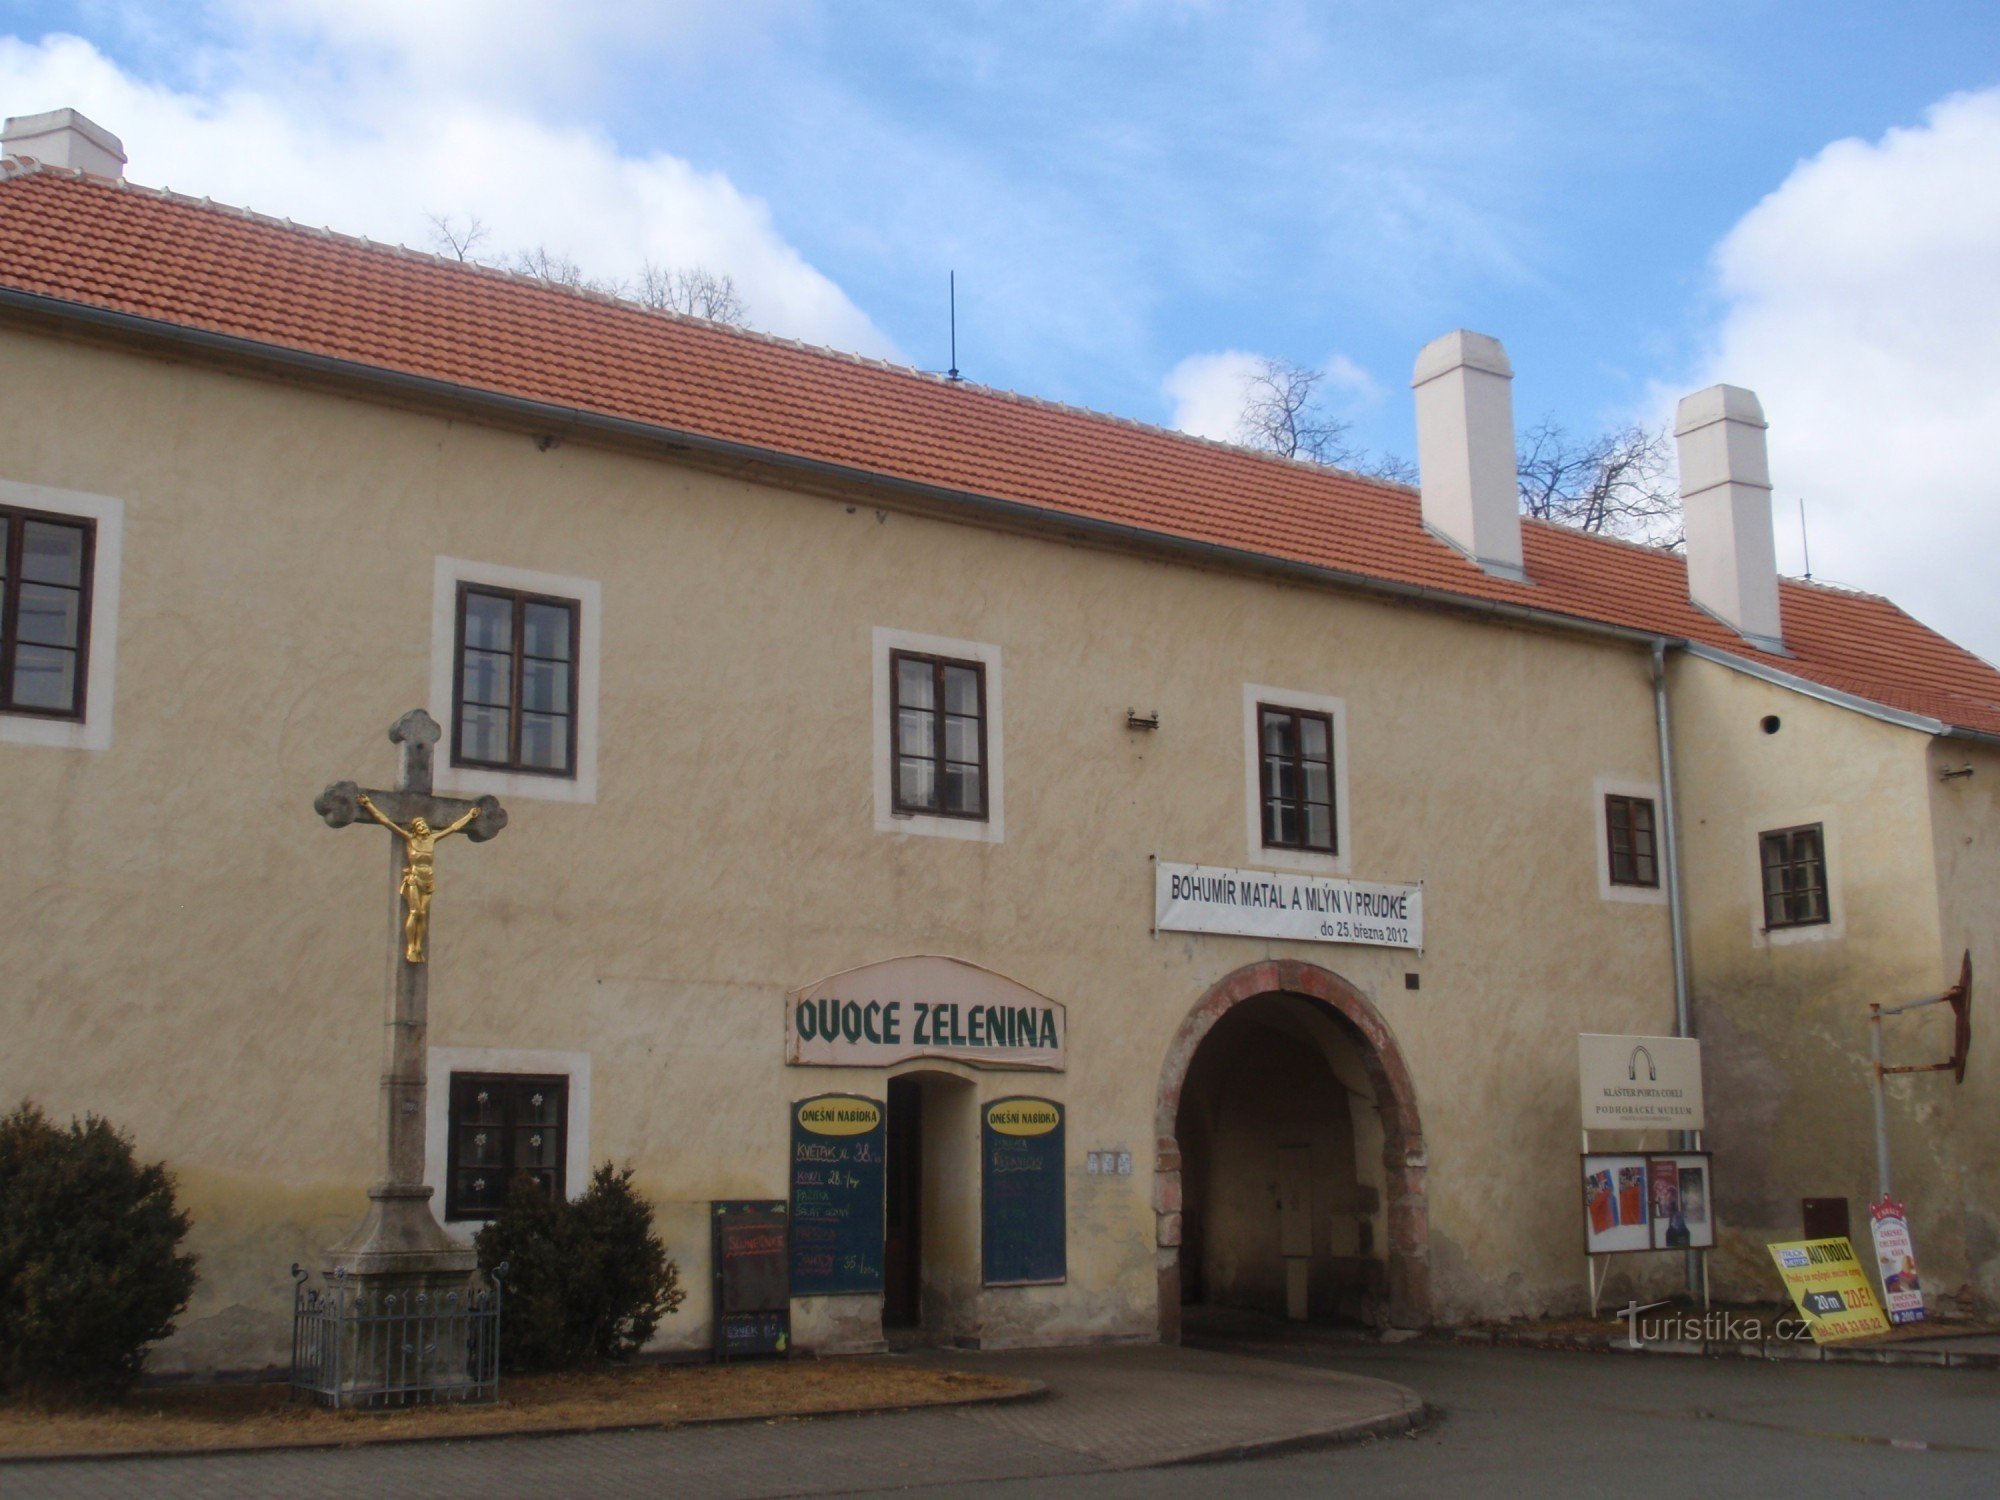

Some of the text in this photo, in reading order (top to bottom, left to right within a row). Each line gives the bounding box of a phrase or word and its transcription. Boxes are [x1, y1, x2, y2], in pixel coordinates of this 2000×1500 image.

[1171, 874, 1408, 920] BOHUMÍR MATAL A MLÝN V PRUDKÉ
[1320, 921, 1409, 944] do 25. března 2012
[913, 1002, 1059, 1049] ZELENINA
[802, 1107, 877, 1122] DNEŠNÍ NABÍDKA
[990, 1110, 1056, 1124] DNEŠNÍ NABÍDKA
[1806, 1240, 1854, 1264] AUTODÍLY
[1814, 1287, 1873, 1310] 20 m ZDE!
